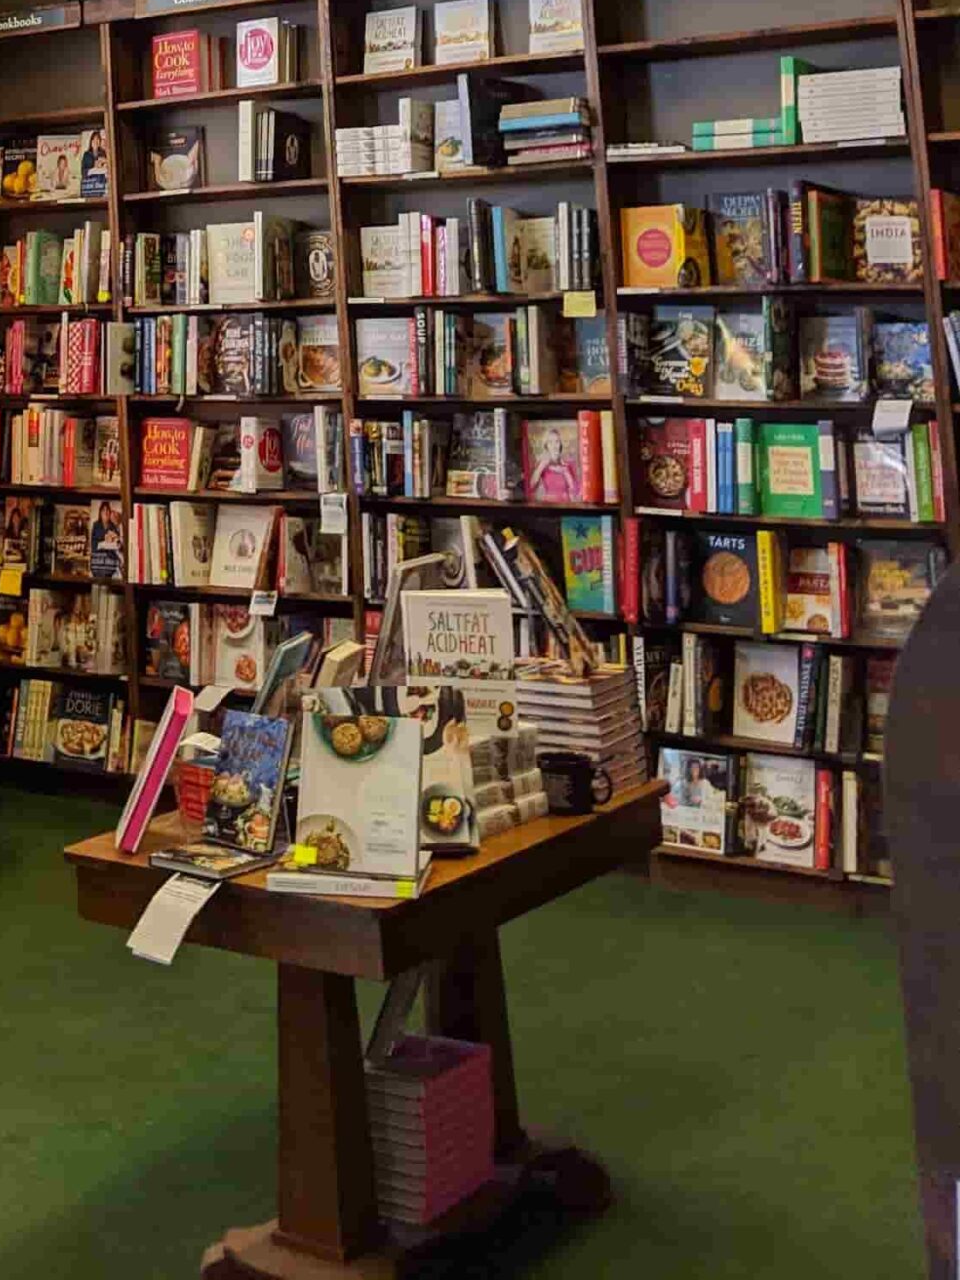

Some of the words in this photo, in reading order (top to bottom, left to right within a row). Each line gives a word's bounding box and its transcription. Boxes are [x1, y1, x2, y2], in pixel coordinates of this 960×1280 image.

[158, 39, 184, 55] How
[416, 312, 427, 344] SOUP
[147, 423, 172, 440] How
[143, 434, 180, 456] Cook
[708, 535, 746, 551] TARTS
[427, 610, 461, 632] SALT
[464, 610, 489, 634] FAT
[426, 631, 458, 653] ACID
[459, 634, 496, 655] HEAT
[65, 699, 103, 715] DORIE
